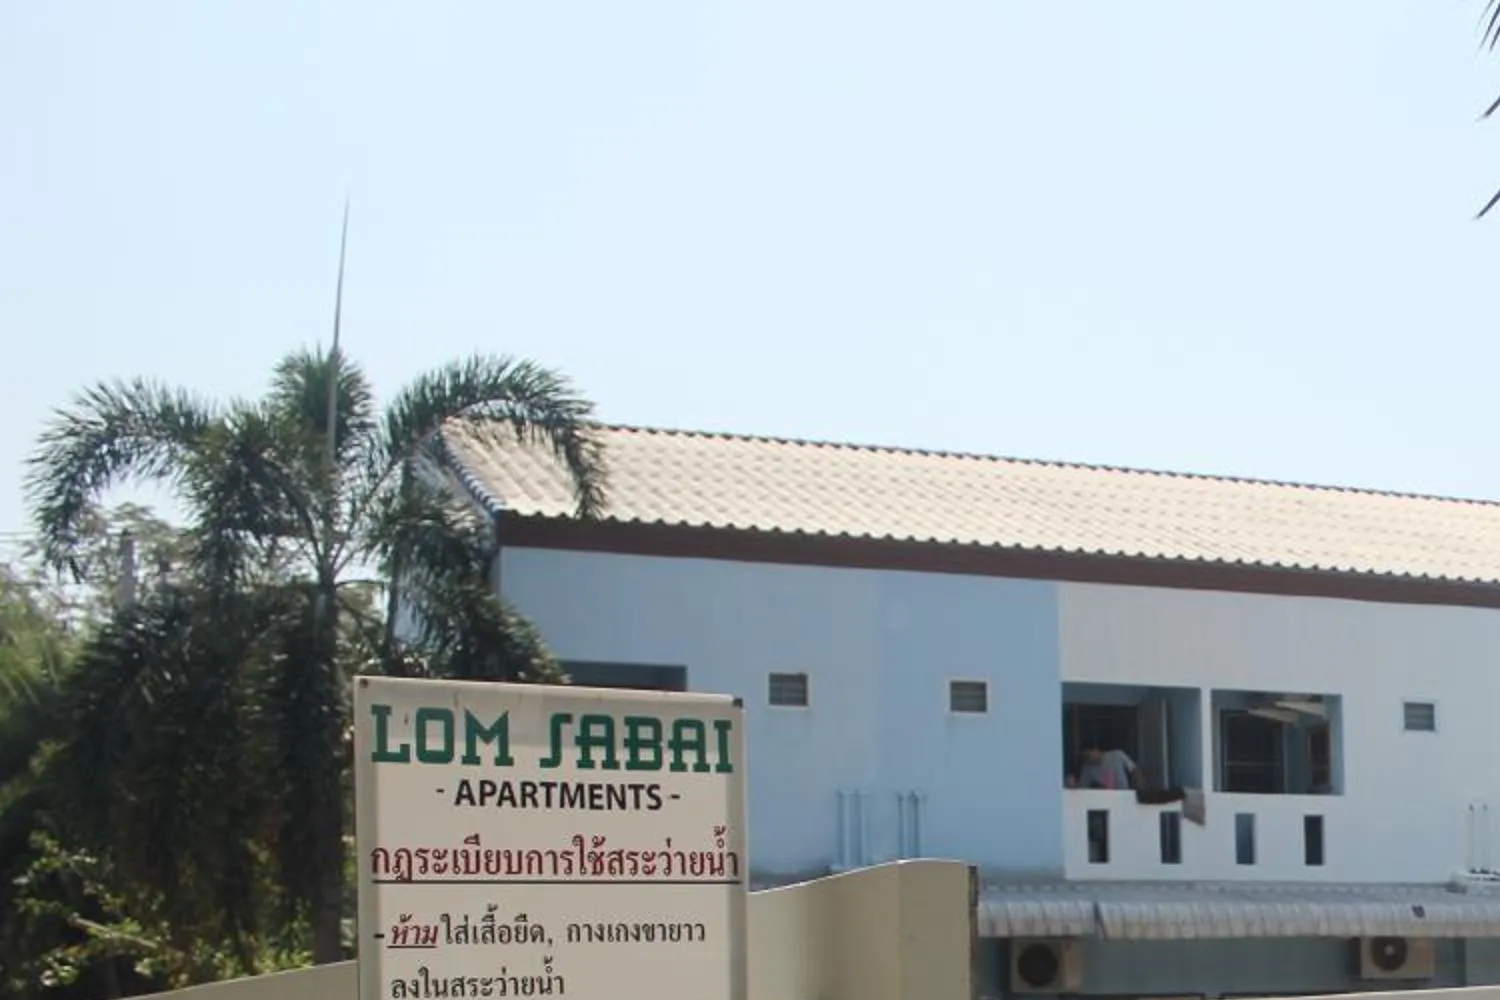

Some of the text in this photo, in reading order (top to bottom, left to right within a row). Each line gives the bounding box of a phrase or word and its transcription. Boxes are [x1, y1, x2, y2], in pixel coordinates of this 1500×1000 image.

[371, 703, 734, 774] LOM SABAI
[454, 779, 663, 811] APARTMENTS
[566, 920, 706, 944] กางเกงขายาว
[390, 956, 566, 999] ลงในสระว่ายน้ำ
